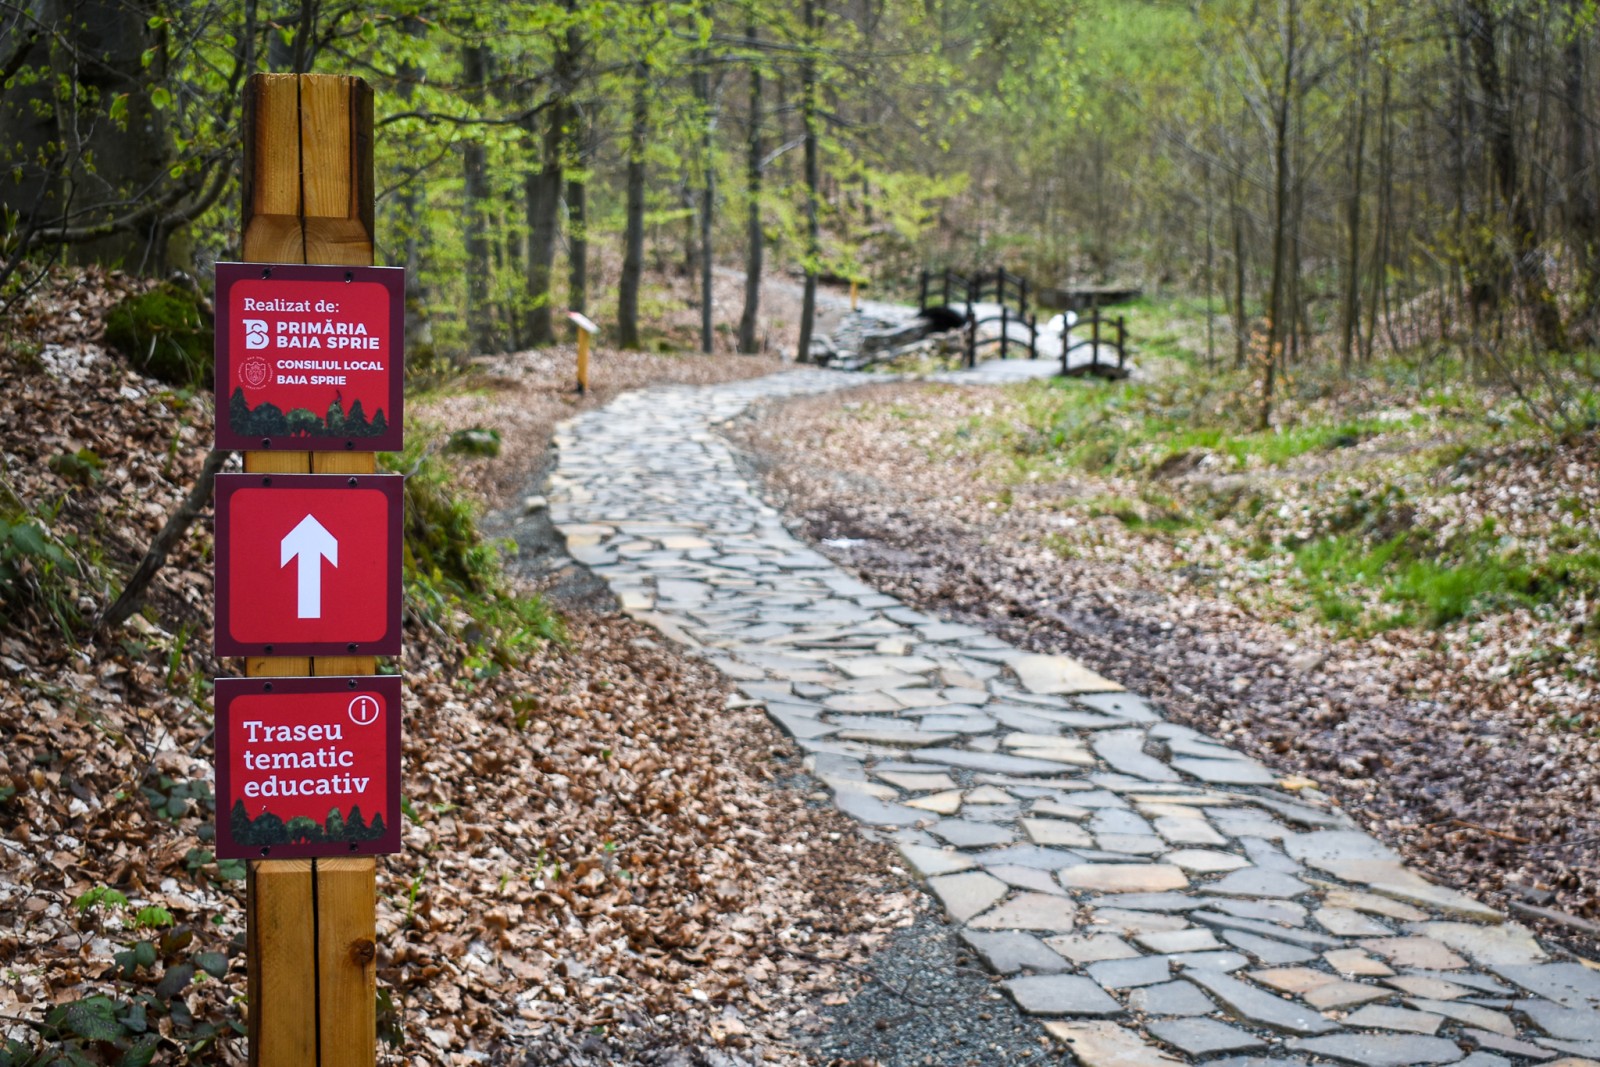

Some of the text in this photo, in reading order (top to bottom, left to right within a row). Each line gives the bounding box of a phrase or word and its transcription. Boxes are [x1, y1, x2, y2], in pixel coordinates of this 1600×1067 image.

[244, 298, 339, 312] Realizat de:
[277, 319, 367, 335] PRIMĂRIA
[277, 336, 379, 349] BAIA SPRIE
[277, 360, 384, 370] CONSILIUL LOCAL
[277, 375, 346, 385] BAIA SPRIE
[243, 721, 343, 742] Traseu
[244, 746, 353, 770] tematic
[244, 773, 370, 797] educativ
